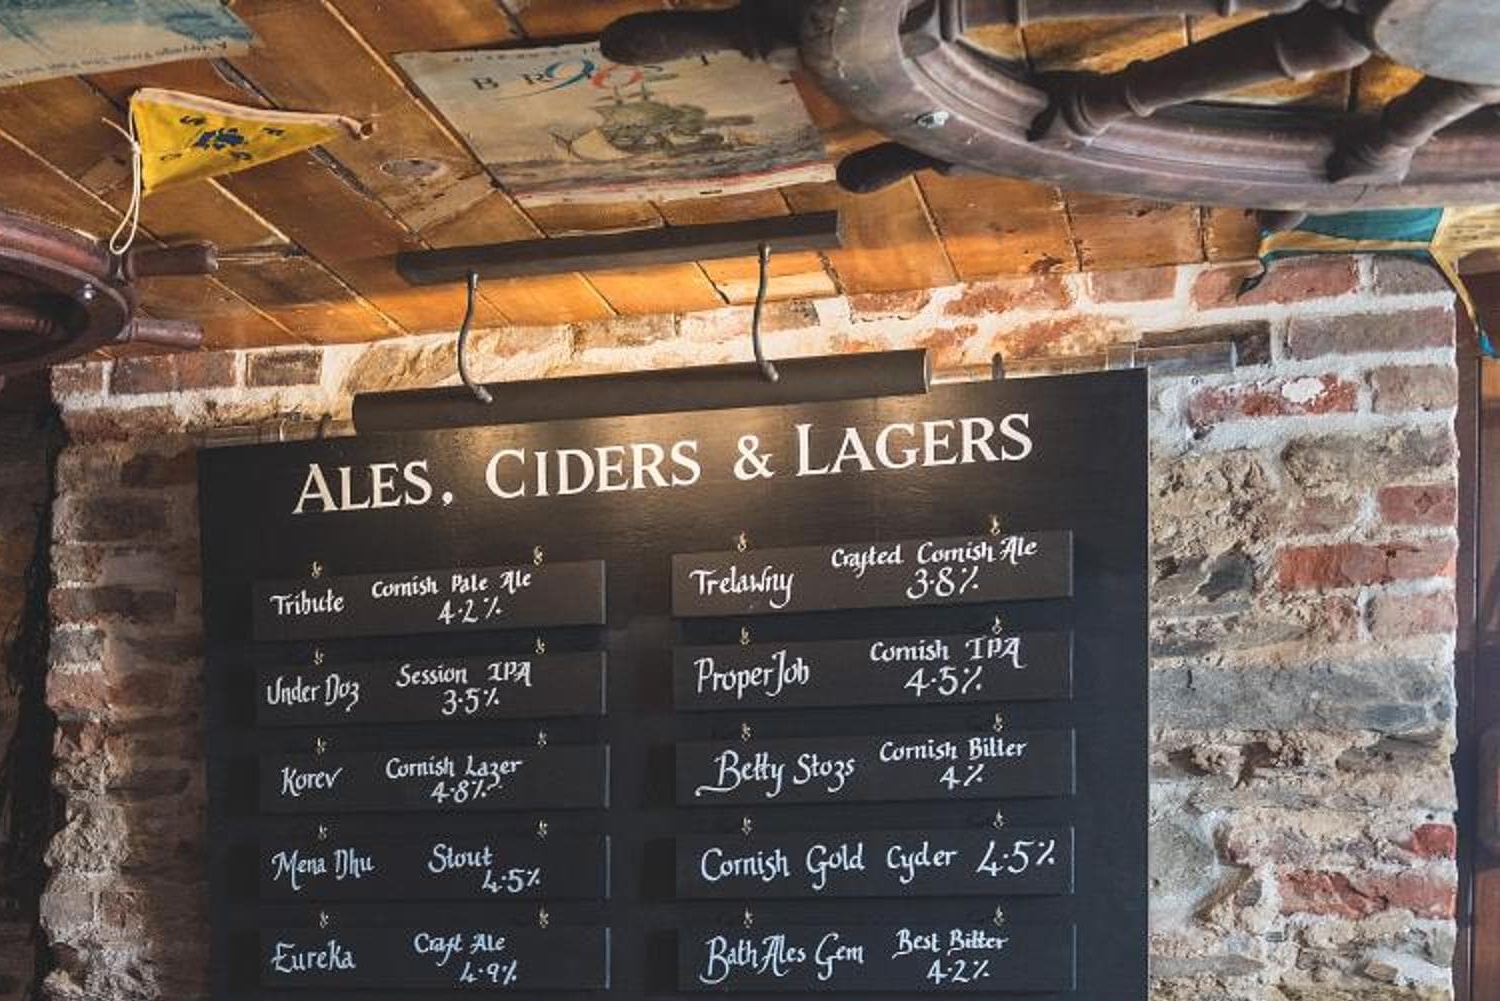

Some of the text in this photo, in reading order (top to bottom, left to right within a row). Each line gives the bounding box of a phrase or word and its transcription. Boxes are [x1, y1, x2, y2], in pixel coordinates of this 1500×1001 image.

[293, 412, 1034, 514] ALES, CIDERS & LAGERS
[831, 535, 1037, 579] Crafted Cornish Ale
[371, 569, 531, 599] Cornish Pale Ale
[689, 565, 795, 609] Trelawny
[269, 588, 345, 615] Tribute
[870, 637, 1024, 669] Cornish IPA
[267, 675, 321, 705] Under
[395, 661, 532, 688] Session IPA
[879, 736, 1027, 762] Cornish Bitter
[281, 767, 343, 797] Korev
[385, 755, 455, 779] Cornish
[695, 749, 786, 798] Betty
[271, 848, 375, 891] Mena Dhu
[427, 843, 493, 873] Stout
[701, 847, 790, 882] Cornish
[806, 842, 865, 891] Gold
[886, 841, 958, 885] Cyder
[413, 932, 506, 967] Craft Ale
[814, 932, 864, 981] Gem
[891, 928, 1009, 959] Best Bitter
